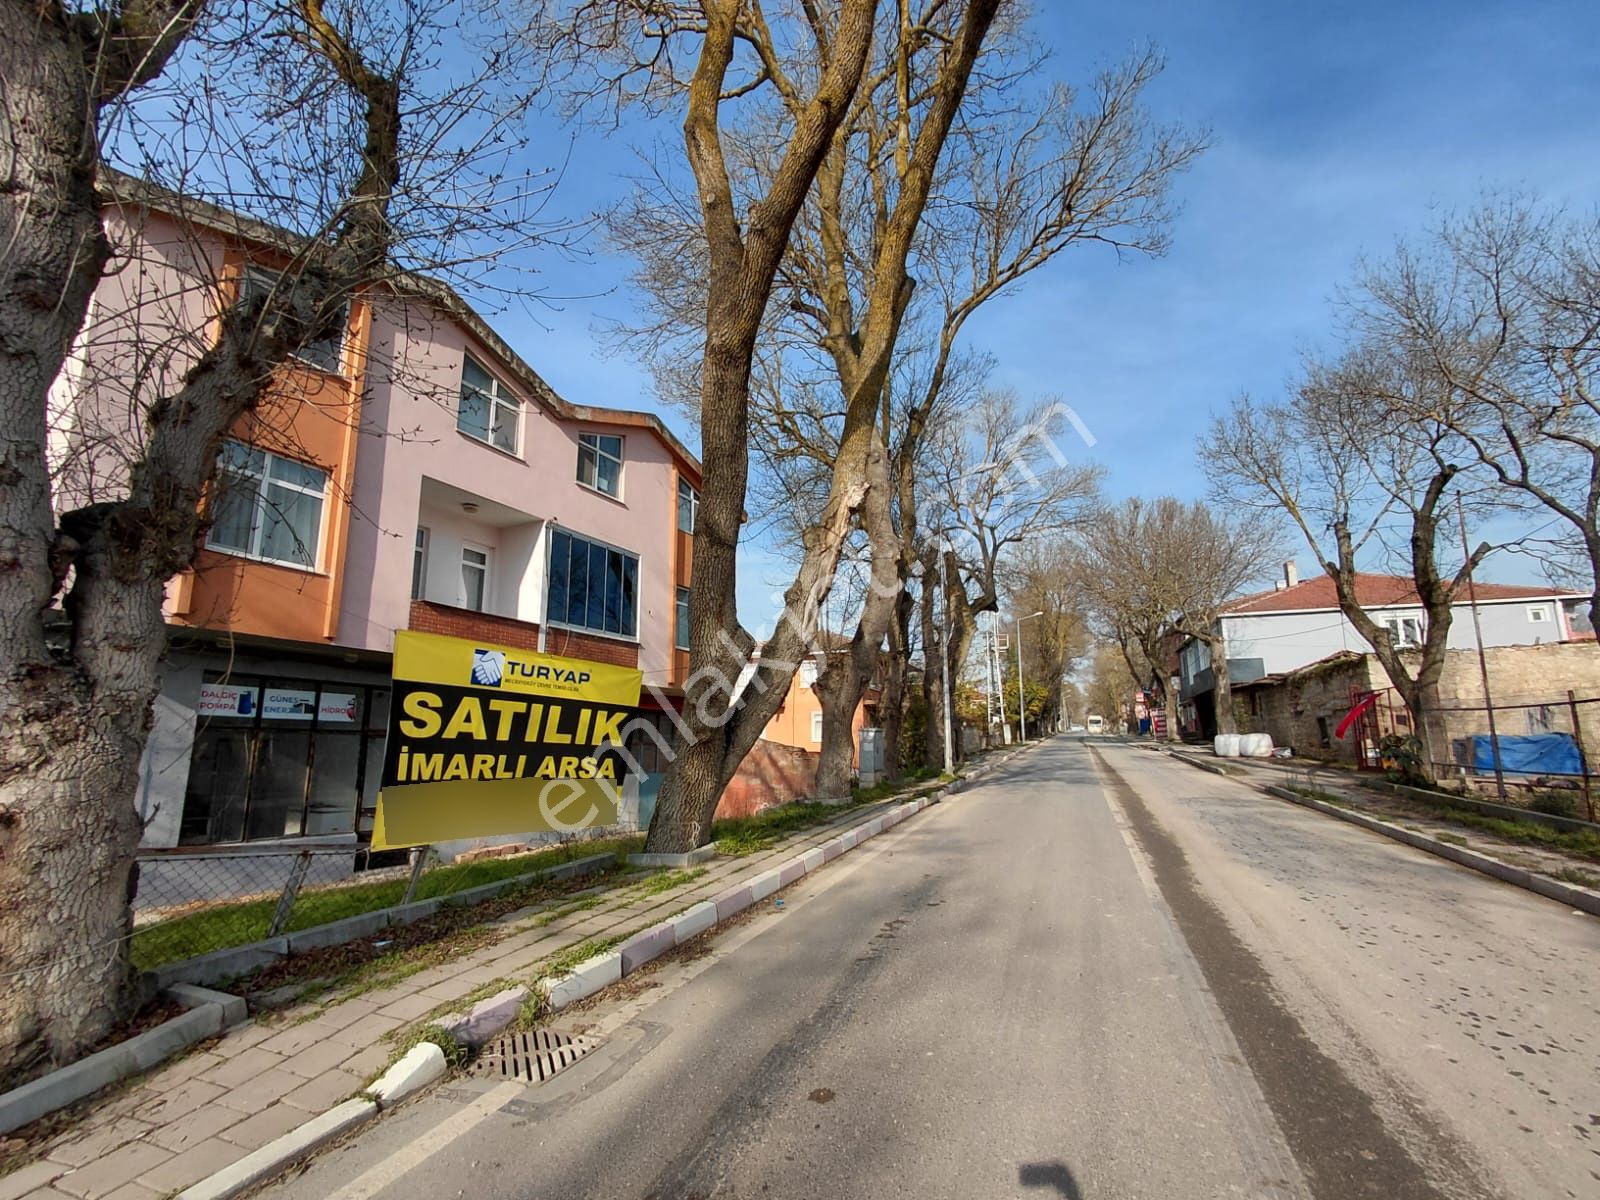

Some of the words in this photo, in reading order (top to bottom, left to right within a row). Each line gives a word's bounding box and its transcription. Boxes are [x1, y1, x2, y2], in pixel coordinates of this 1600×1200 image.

[507, 661, 590, 684] TURYAP
[199, 702, 236, 710] POMPA
[400, 691, 629, 746] SATILIK
[397, 746, 527, 781] İMARLI
[534, 756, 616, 779] ARSA
